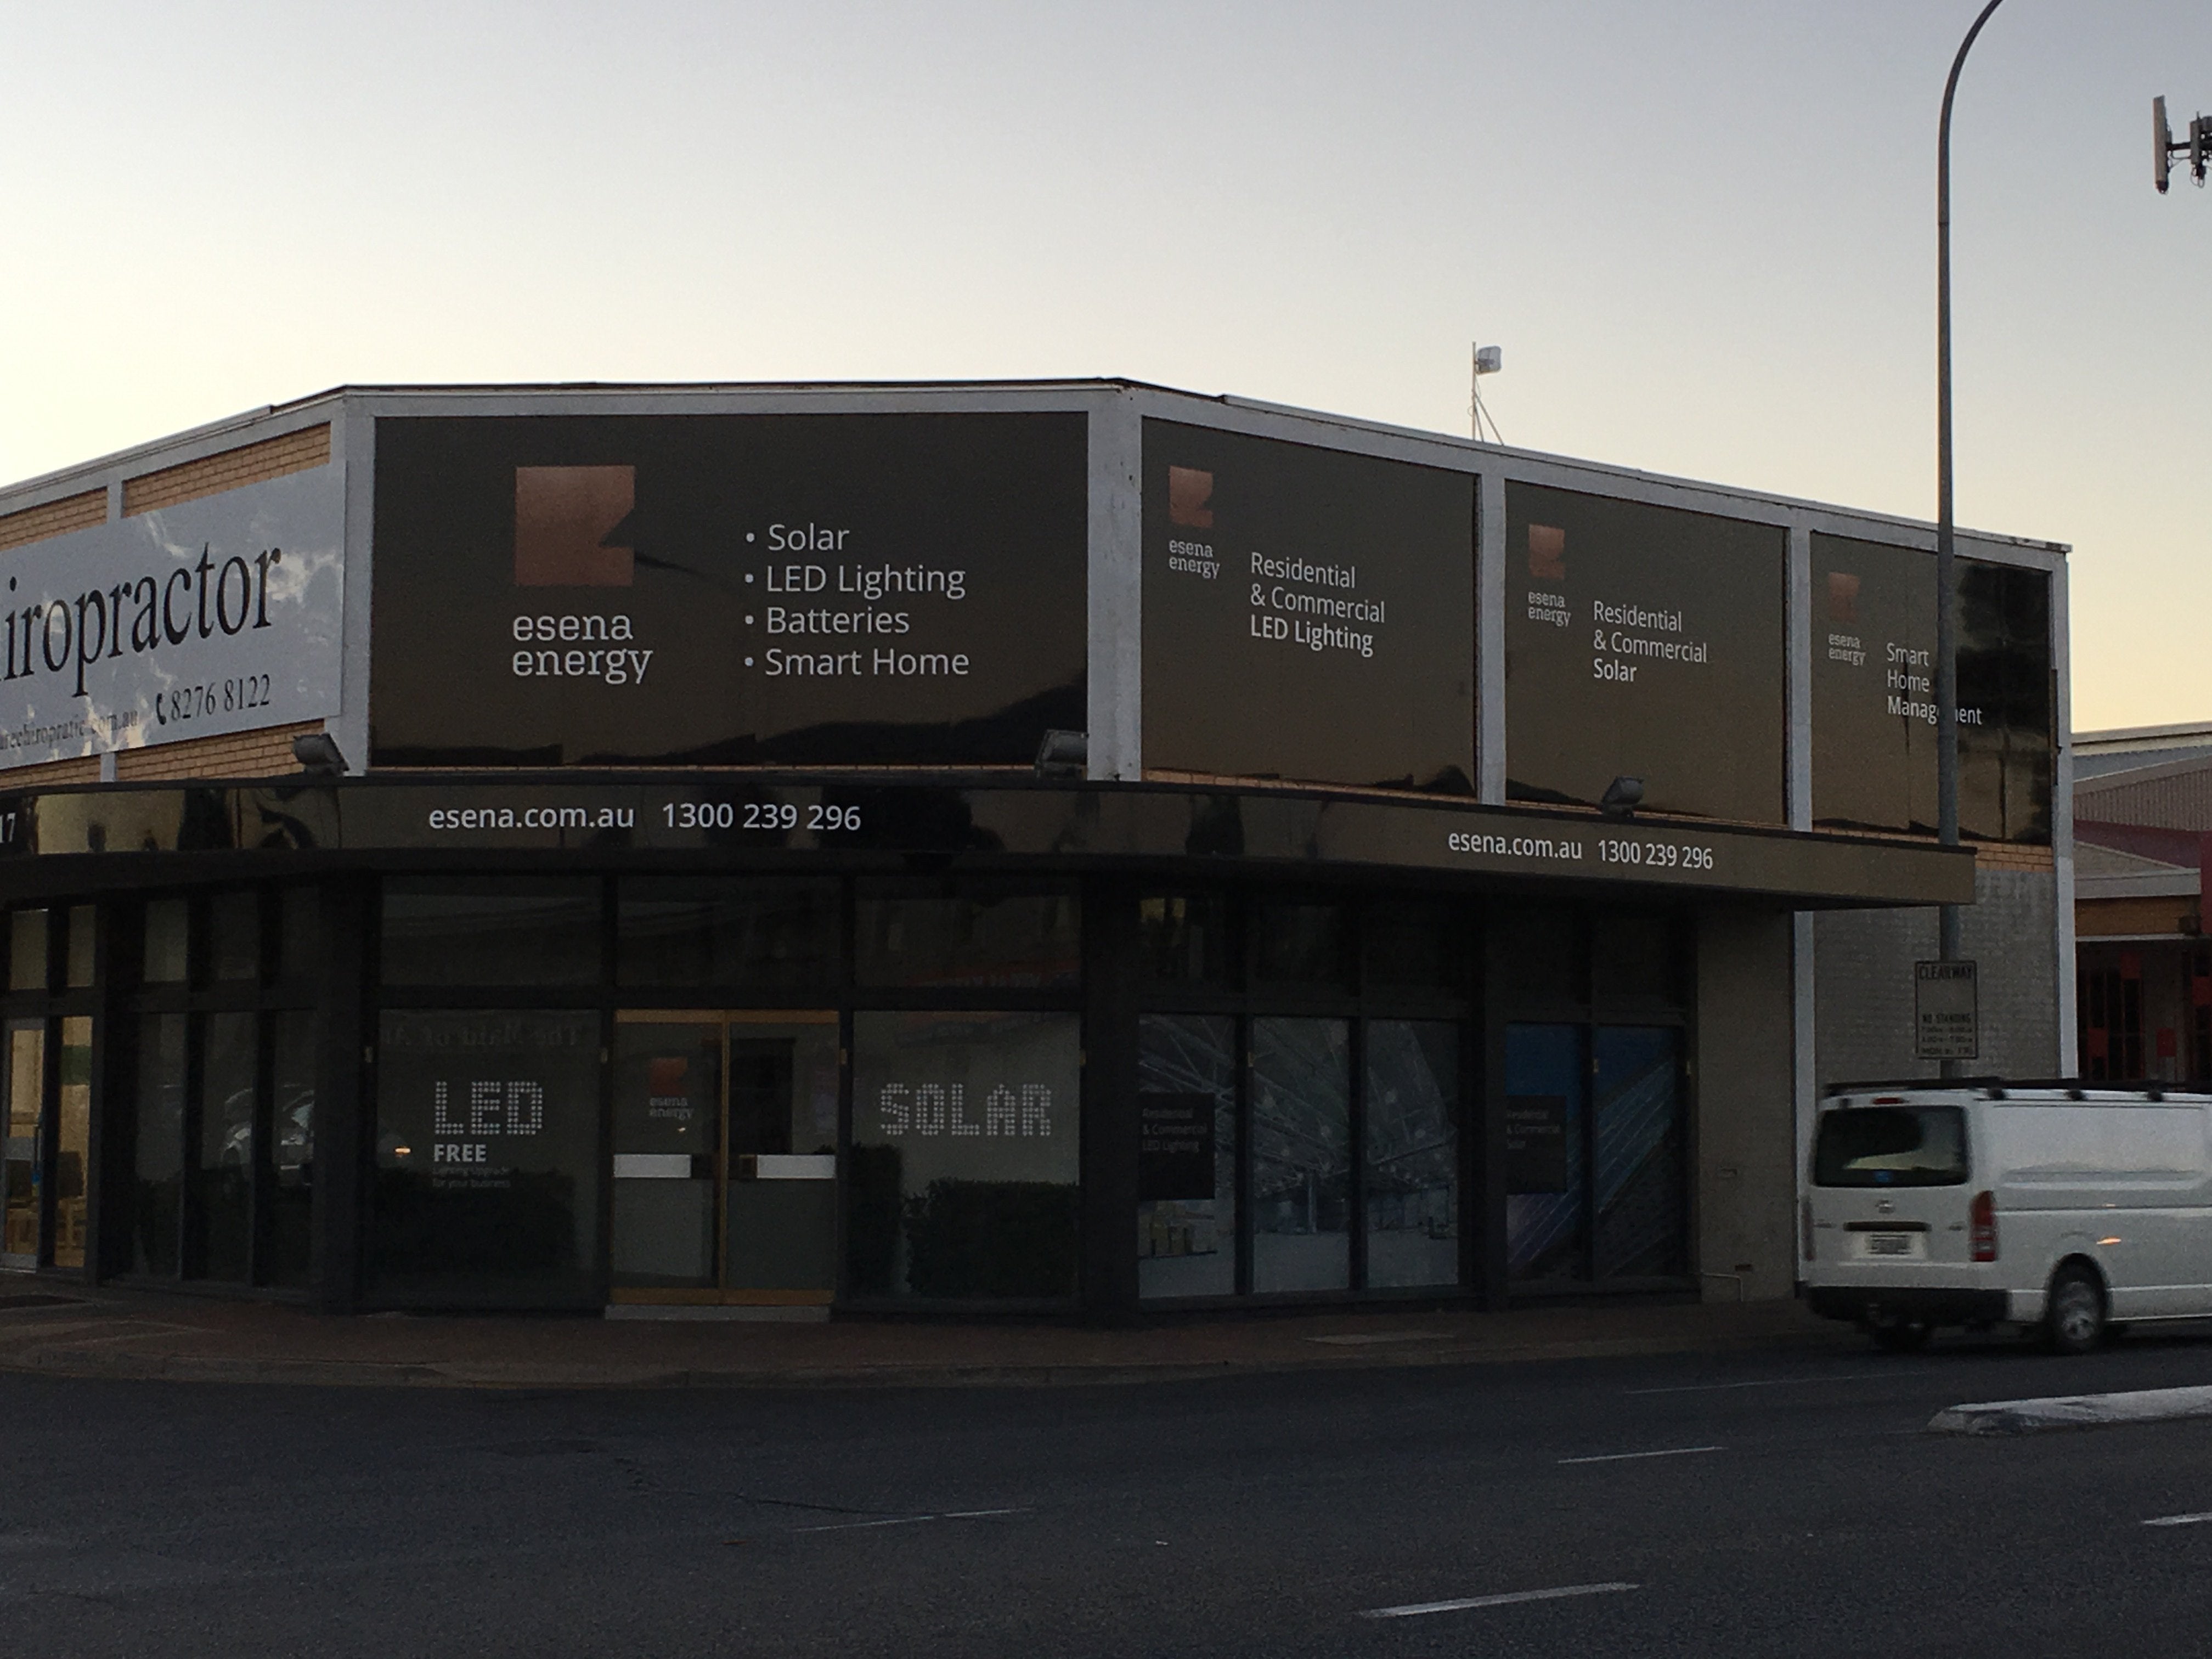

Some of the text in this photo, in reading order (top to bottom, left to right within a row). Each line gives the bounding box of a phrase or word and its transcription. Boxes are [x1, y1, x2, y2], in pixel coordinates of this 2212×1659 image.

[769, 523, 849, 550] Solar
[1169, 539, 1213, 558] esena
[1169, 555, 1220, 579] energy
[1251, 552, 1355, 589] Residential
[768, 564, 965, 600] LED Lighting
[1251, 584, 1385, 623] & Commercial
[1528, 591, 1566, 608] esena
[0, 541, 281, 697] iropractor
[514, 616, 633, 641] esena
[768, 606, 909, 633] Batteries
[1528, 606, 1571, 628] energy
[1594, 600, 1681, 632] Residential
[1251, 614, 1373, 657] LED Lighting
[1594, 629, 1707, 663] & Commercial
[1828, 633, 1861, 649] esena
[513, 648, 653, 684] energy
[766, 648, 968, 675] Smart Home
[1828, 647, 1866, 666] energy
[1887, 642, 1929, 667] Smart
[1594, 658, 1637, 681] Solar
[1887, 669, 1930, 693] Home
[172, 674, 269, 720] 8276 8122
[1887, 696, 1983, 725] Managent
[430, 803, 860, 830] esena.com.au 1300 239 296
[1449, 833, 1713, 869] esena.com.au 1300 239 296
[1919, 965, 1972, 979] CLEARWAY
[435, 1082, 542, 1135] LED
[649, 1107, 694, 1120] energy
[881, 1084, 1051, 1136] SOLAR
[435, 1144, 486, 1162] FREE
